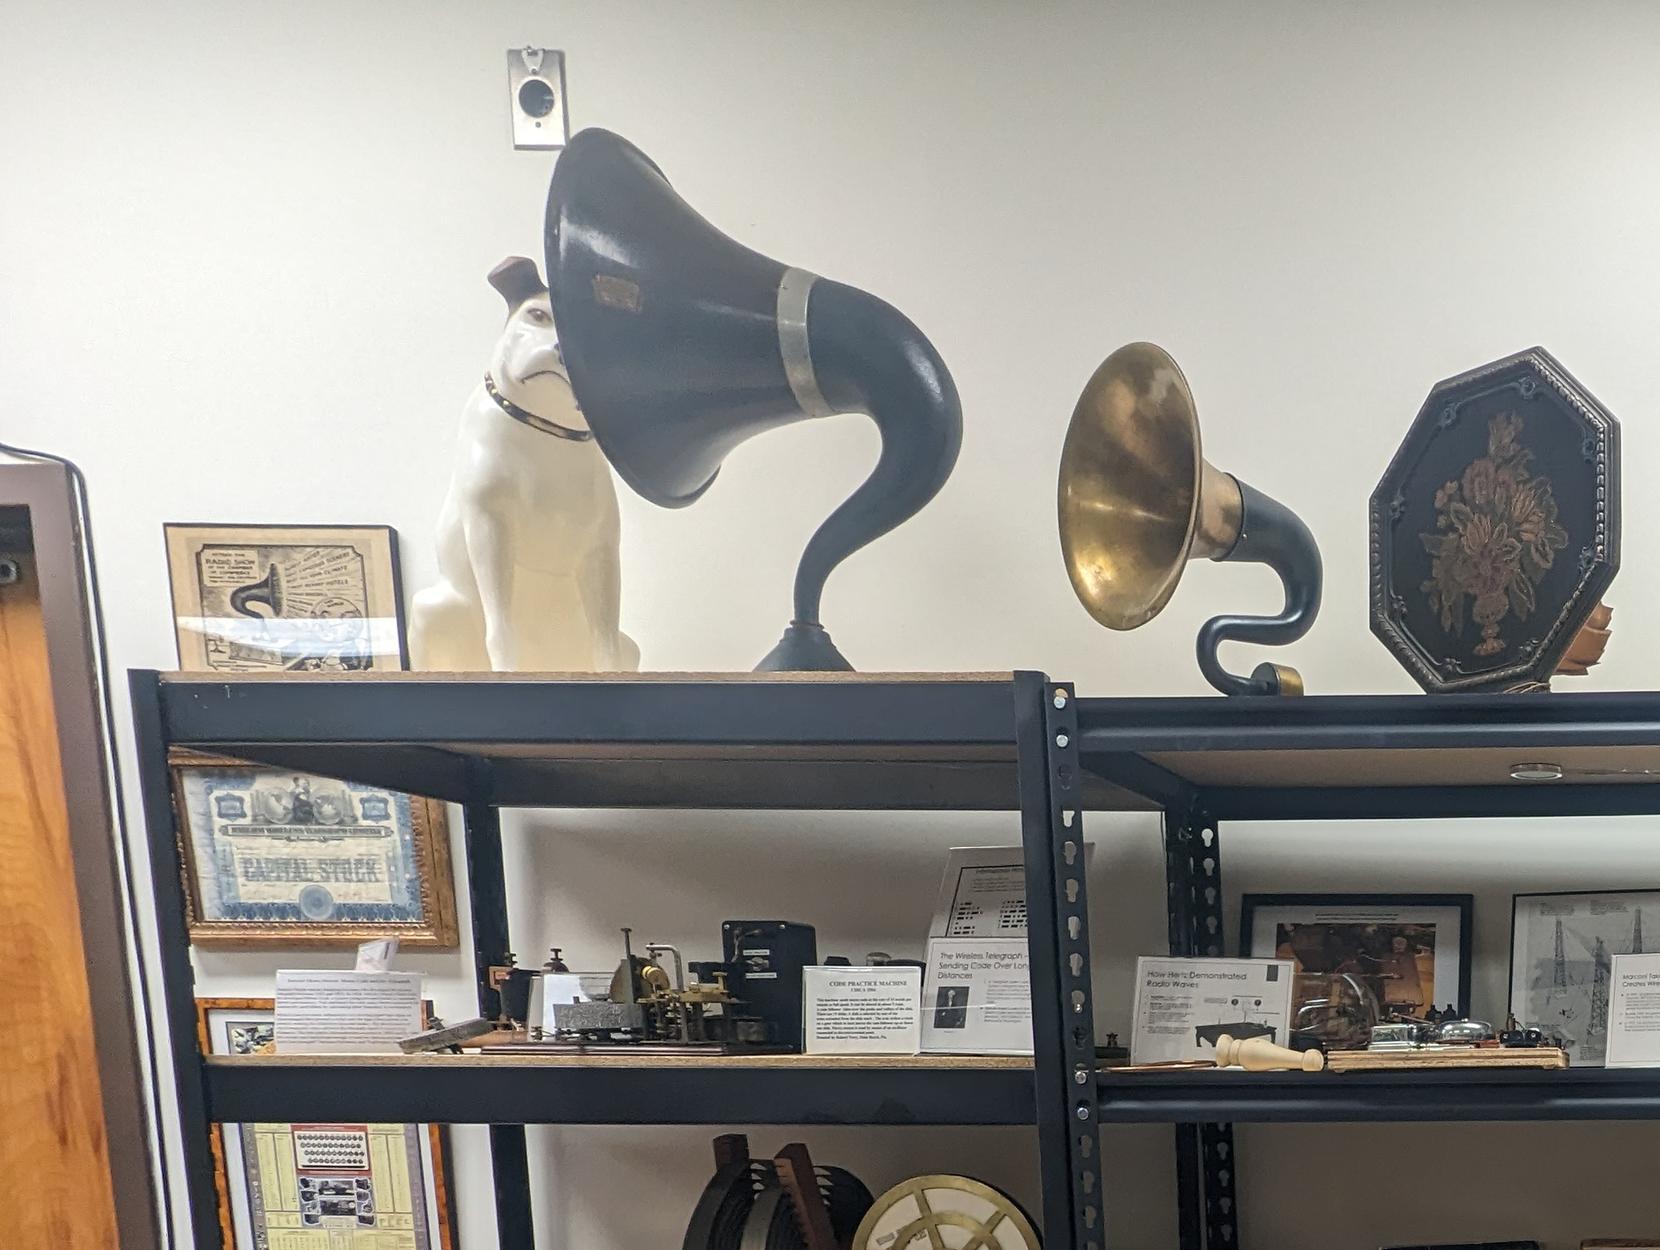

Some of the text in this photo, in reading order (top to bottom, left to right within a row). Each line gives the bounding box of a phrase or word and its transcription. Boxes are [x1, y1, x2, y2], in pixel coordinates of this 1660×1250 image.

[955, 952, 984, 960] Wireless
[986, 952, 1023, 962] Telegraph
[939, 962, 968, 970] Sending
[971, 962, 991, 970] Code
[1014, 962, 1029, 970] Lon
[1190, 972, 1247, 980] Demonstrated
[1147, 980, 1170, 988] Radio
